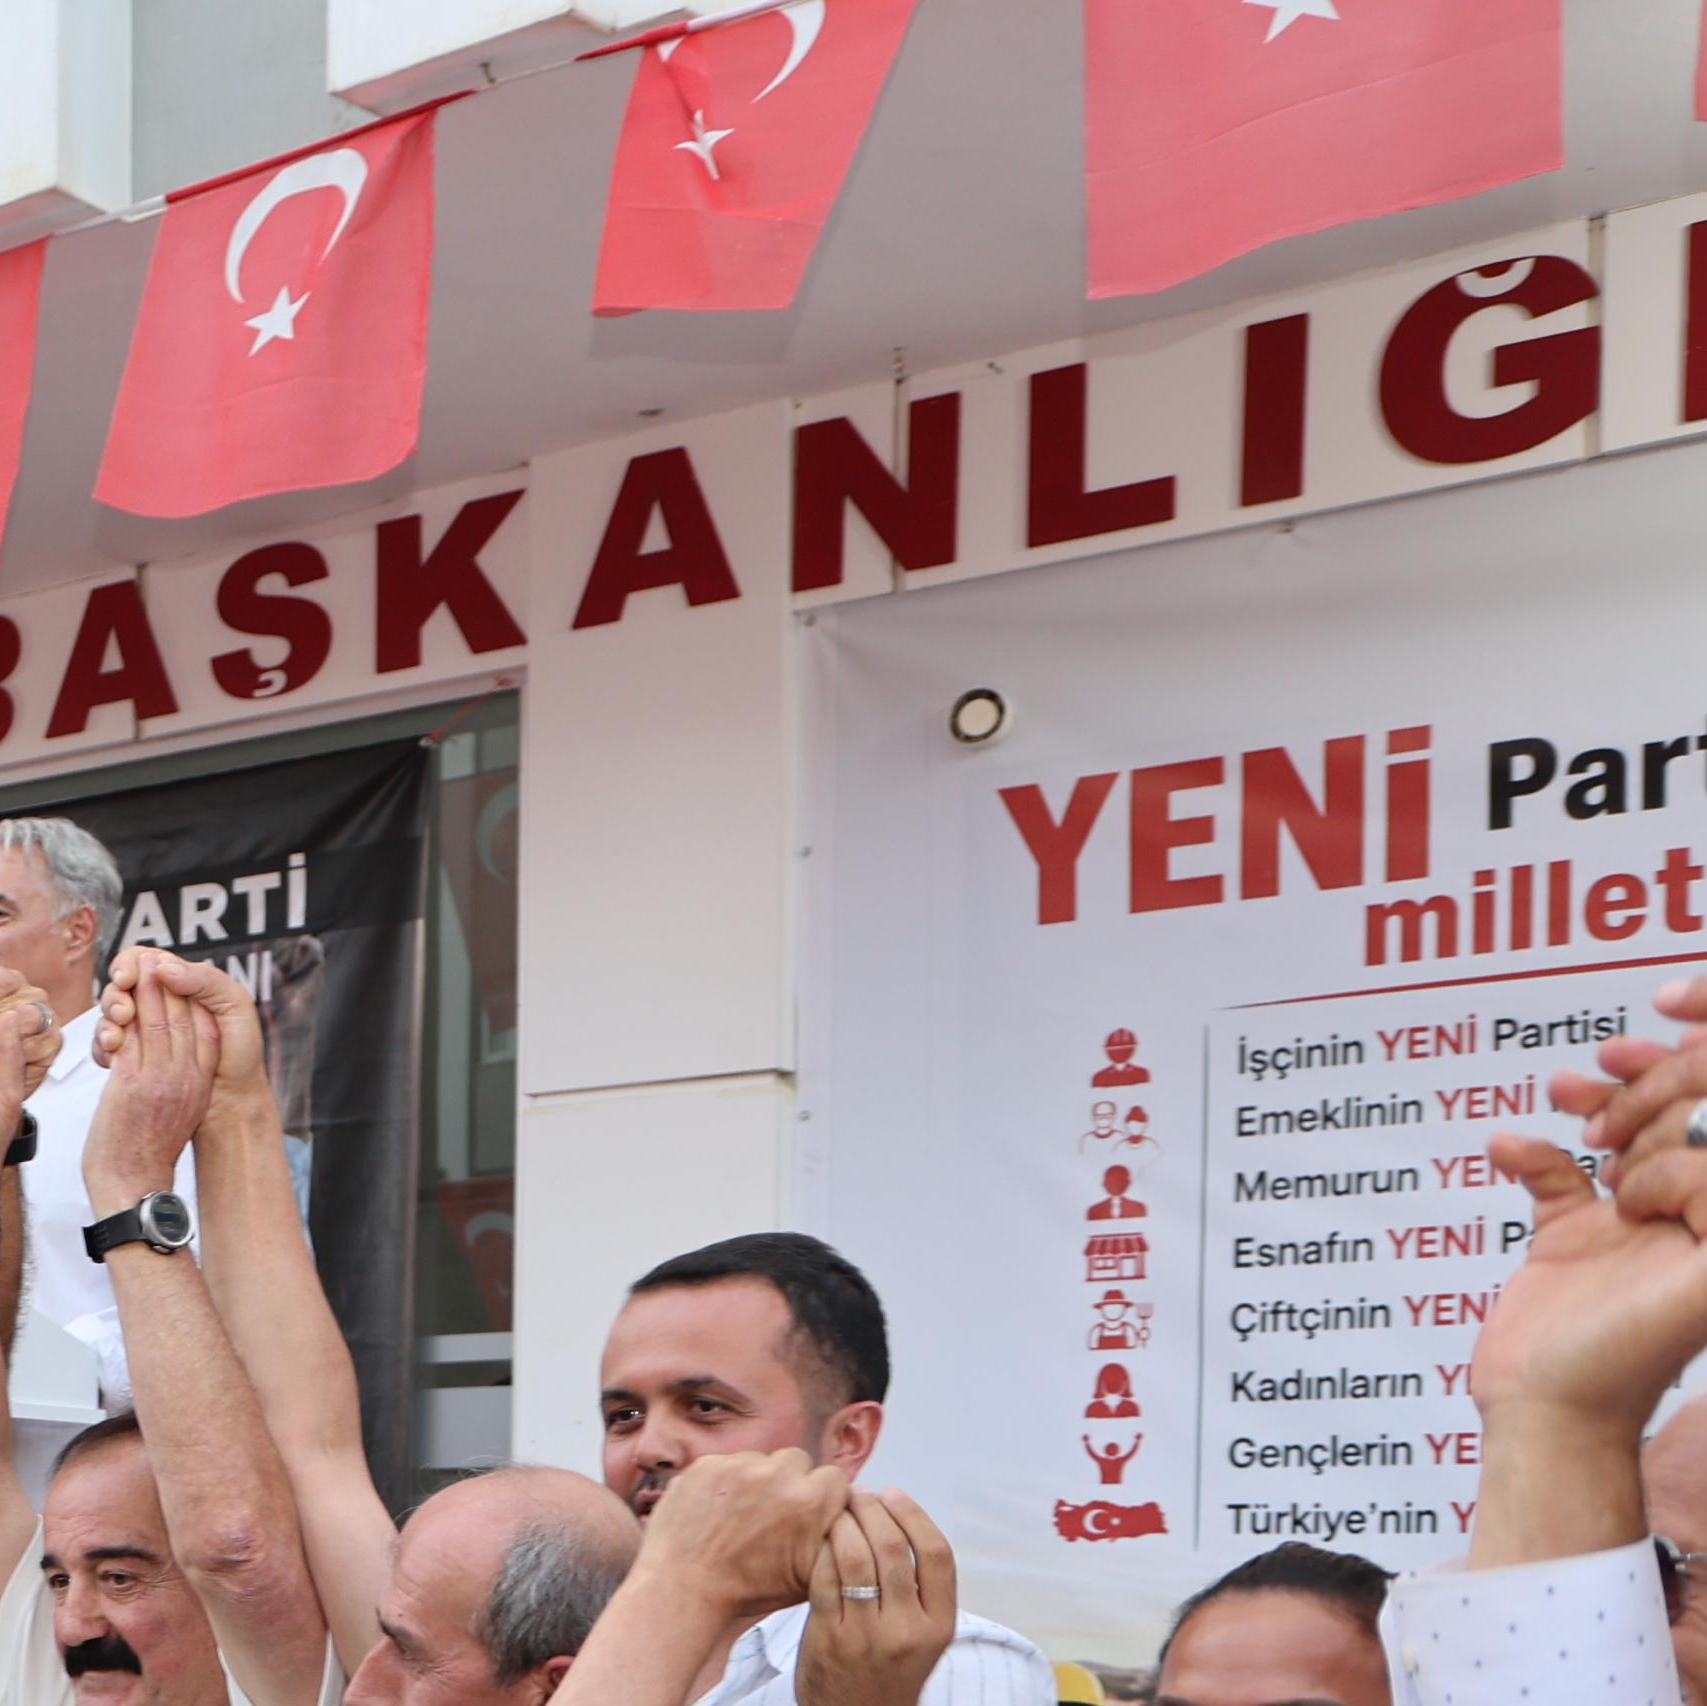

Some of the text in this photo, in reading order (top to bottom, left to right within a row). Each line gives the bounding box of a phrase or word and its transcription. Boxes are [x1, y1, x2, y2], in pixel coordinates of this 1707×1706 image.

[118, 853, 308, 953] ARTİ
[1237, 1006, 1628, 1081] İşçinin YENİ Partisi
[1236, 1075, 1537, 1138] Emeklinin YENİ
[1234, 1167, 1419, 1203] Memurun
[1233, 1231, 1375, 1269] Esnafın
[1386, 1216, 1487, 1260] YENİ
[1230, 1298, 1391, 1341] Çiftçinin
[1231, 1367, 1424, 1402] Kadınların
[1228, 1434, 1414, 1475] Gençlerin
[1226, 1502, 1439, 1542] Türkiye’nin
